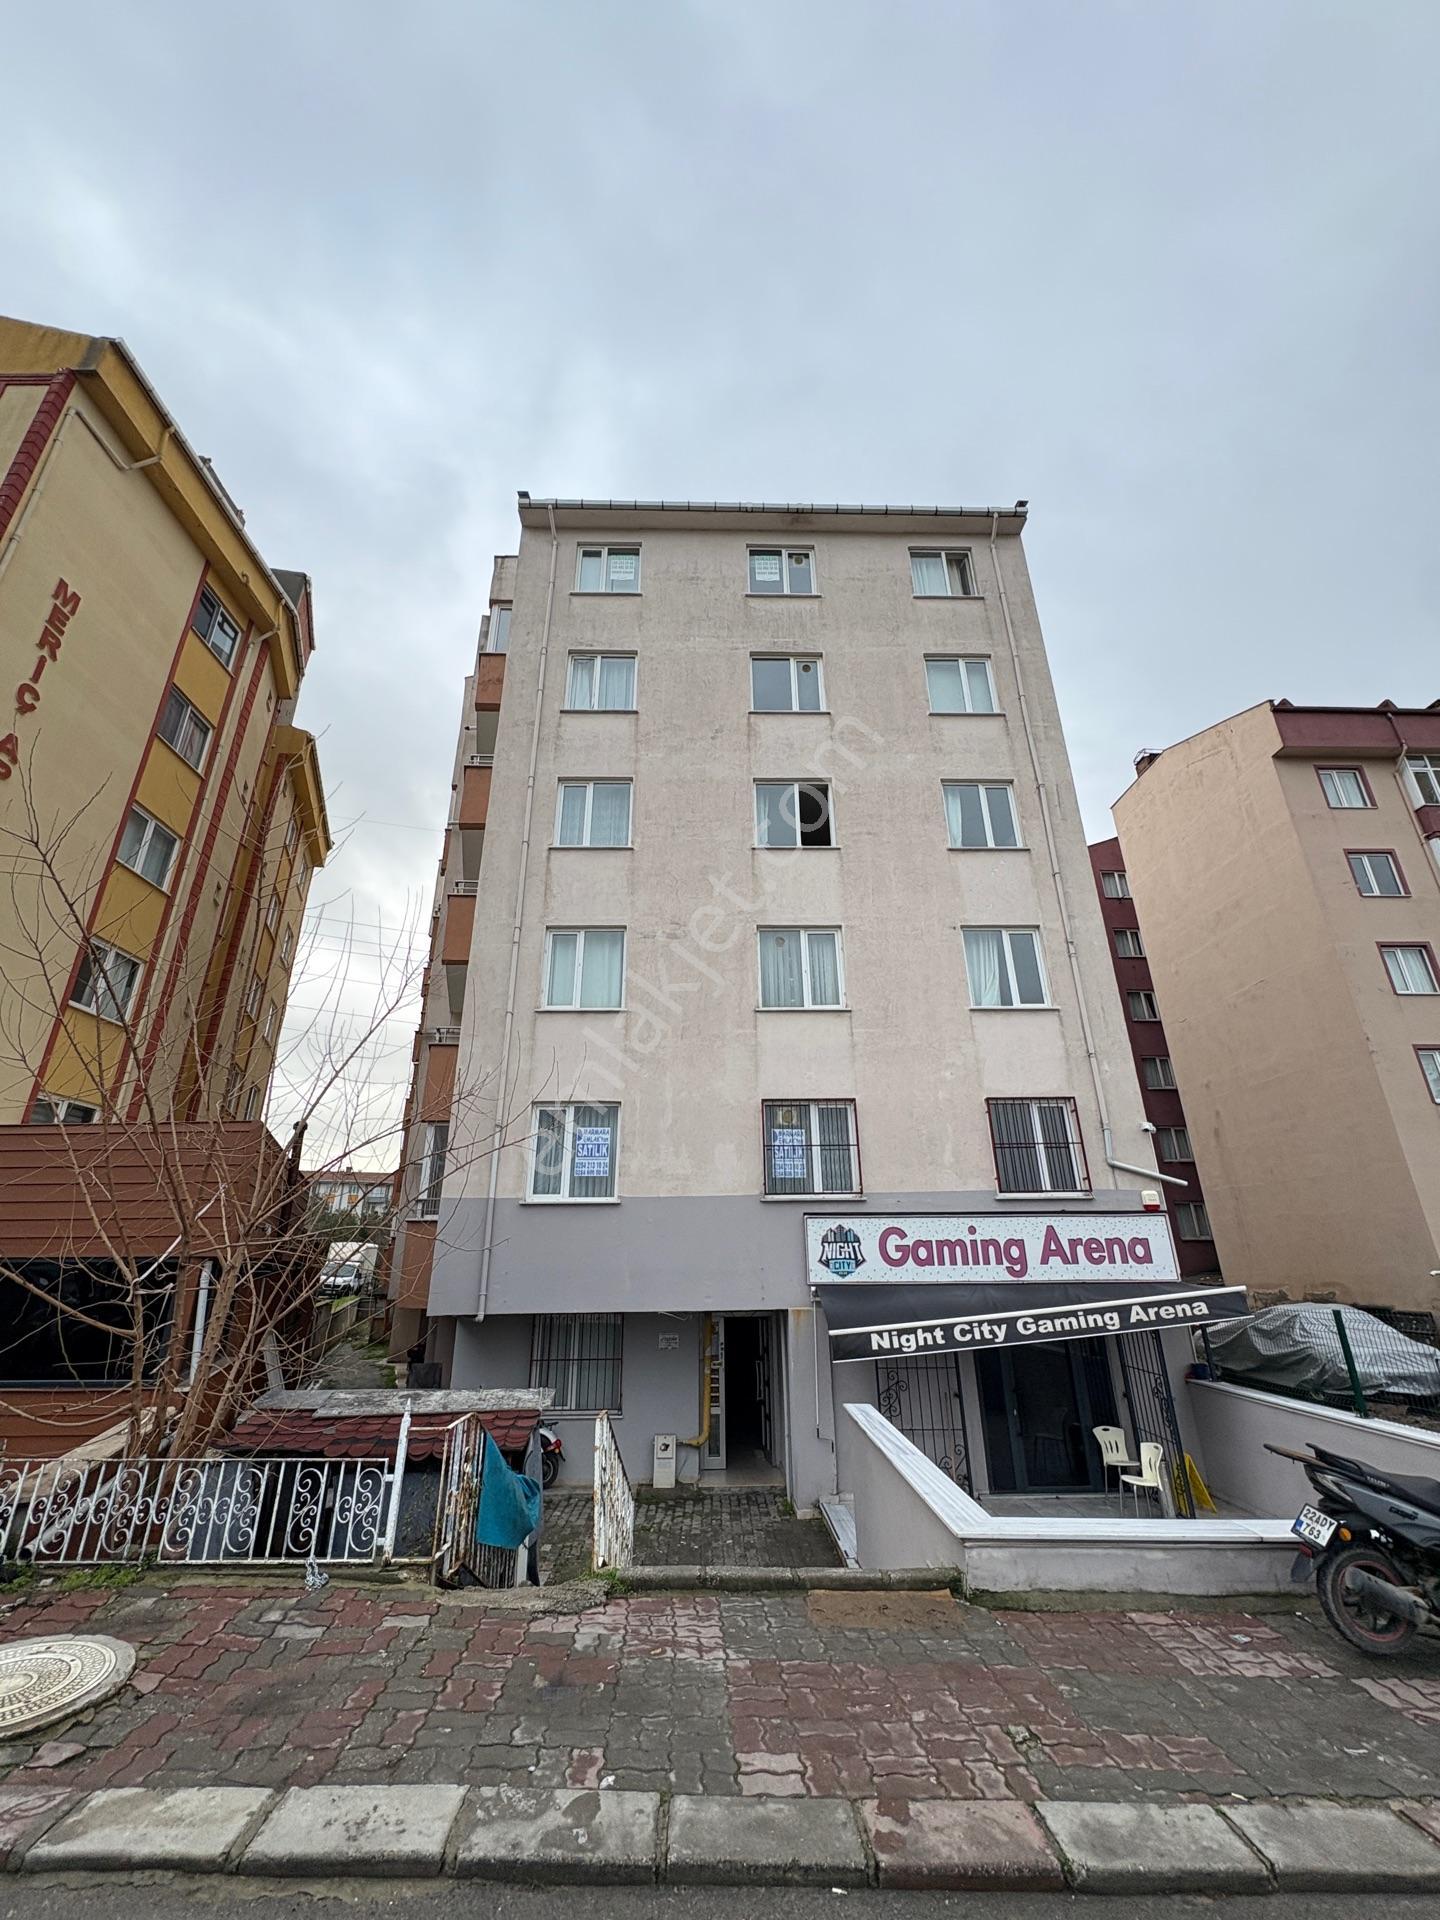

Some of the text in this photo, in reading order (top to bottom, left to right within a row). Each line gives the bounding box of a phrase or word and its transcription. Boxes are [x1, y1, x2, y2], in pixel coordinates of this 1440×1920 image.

[577, 1144, 608, 1157] SATILIK
[821, 1243, 863, 1262] NIGHT
[878, 1225, 1153, 1278] Gaming Arena
[833, 1261, 851, 1270] CITY
[871, 1301, 1209, 1353] Night City Gaming Arena
[1303, 1522, 1321, 1539] 763
